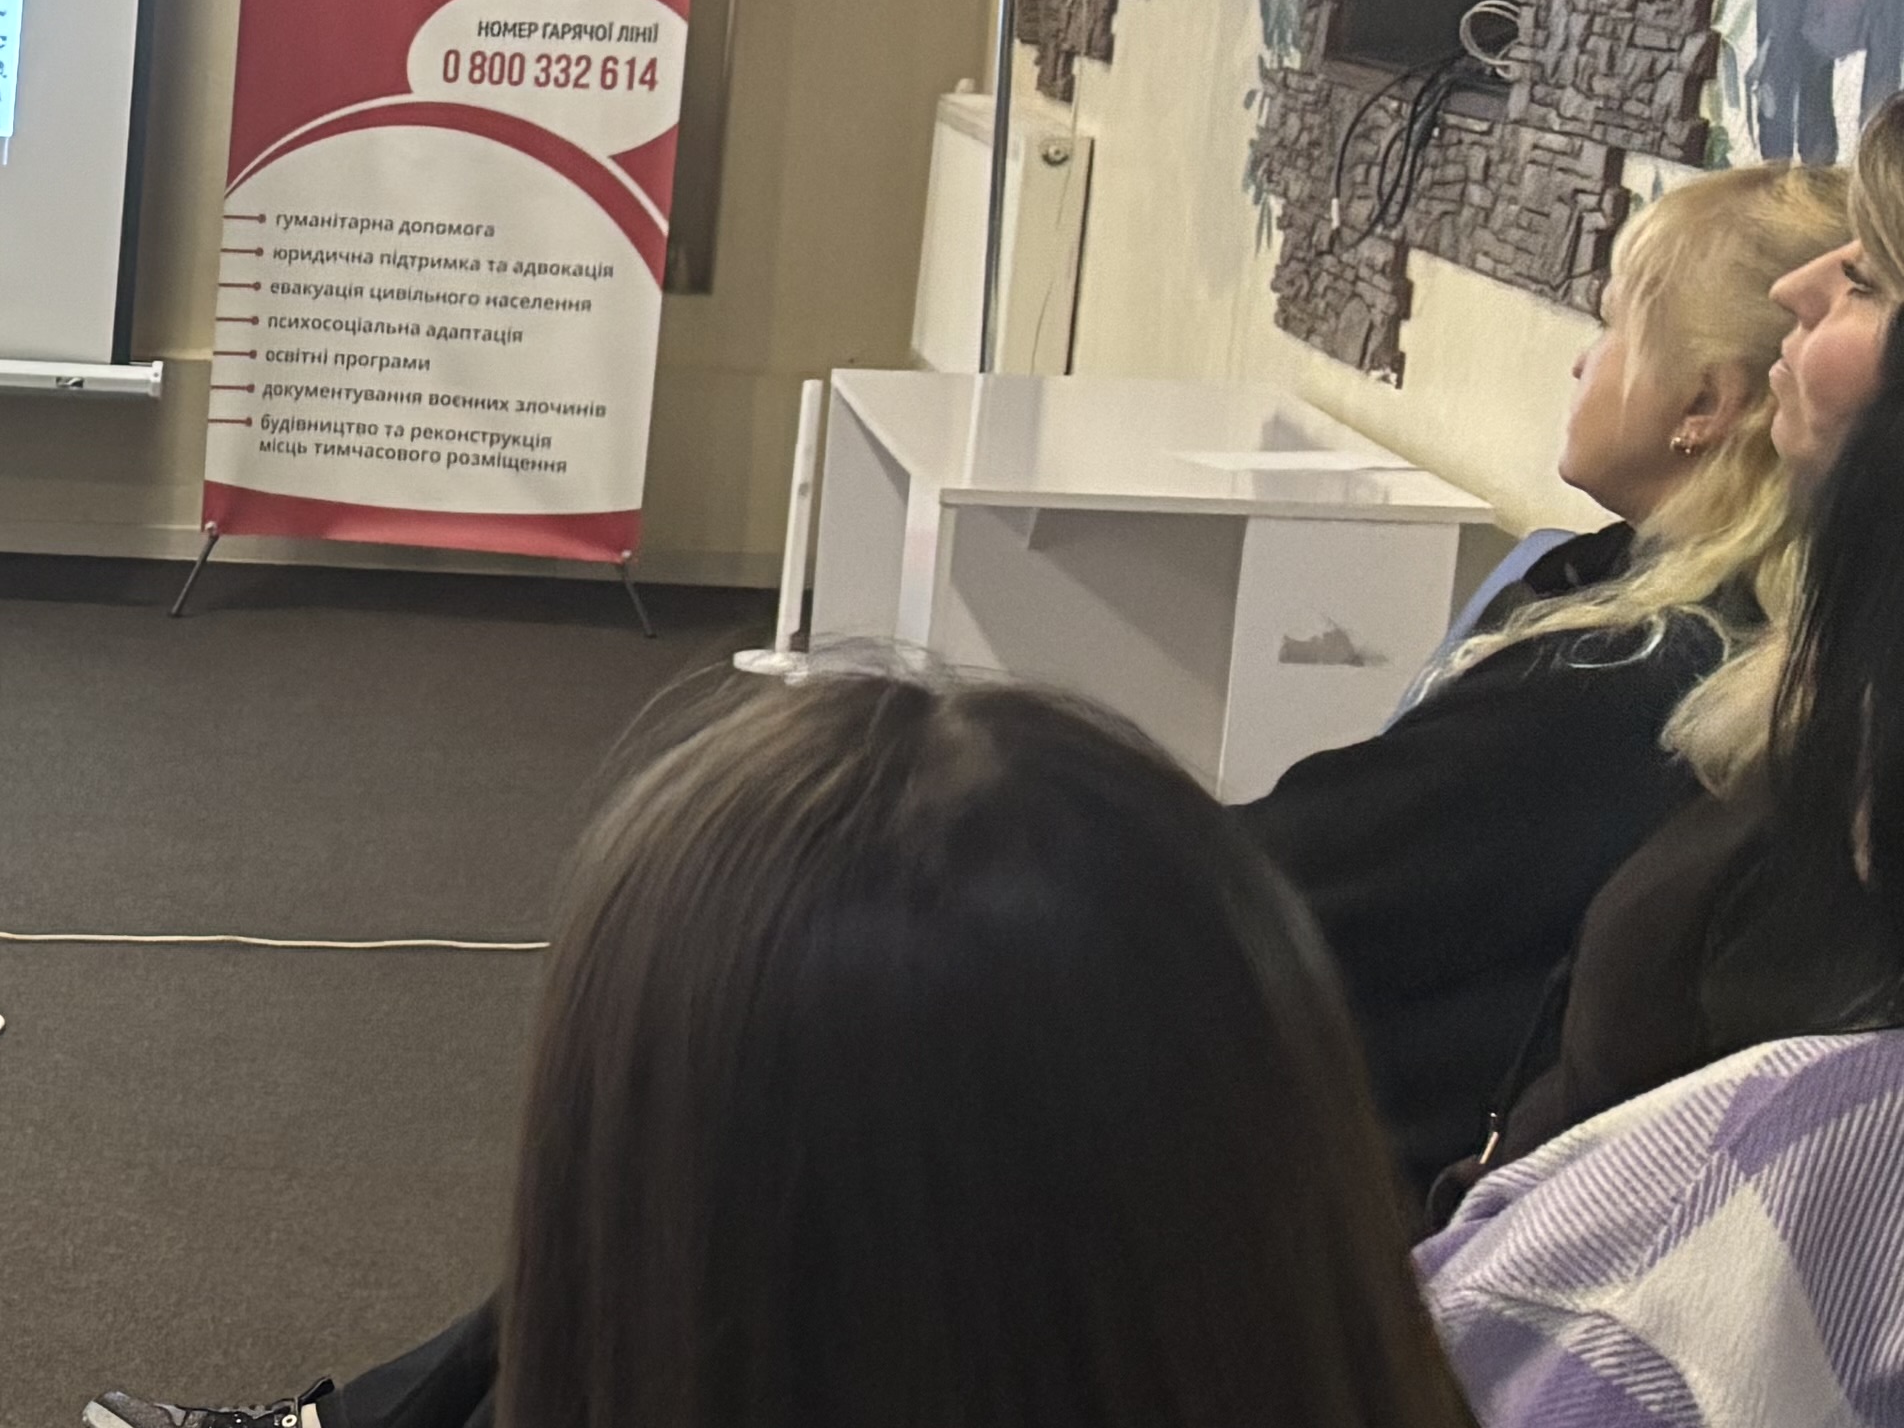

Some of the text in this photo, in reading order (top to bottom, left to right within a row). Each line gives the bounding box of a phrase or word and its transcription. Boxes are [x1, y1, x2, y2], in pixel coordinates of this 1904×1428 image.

[476, 20, 538, 40] НОМЕР
[541, 20, 613, 43] ГАРЯЧОЇ
[442, 49, 660, 93] 0 800 332 614
[275, 212, 496, 239] гуманітарна допомога
[272, 246, 615, 281] юридична підтримка та адвокація
[269, 280, 593, 314] евакуація цивільного населення
[267, 314, 524, 345] психосоціальна адаптація
[264, 347, 432, 373] освітні програми
[261, 382, 607, 419] документування воєнних злочинів
[260, 413, 553, 451] будівництво та реконструкція
[258, 437, 568, 475] місць тимчасового розміщення
